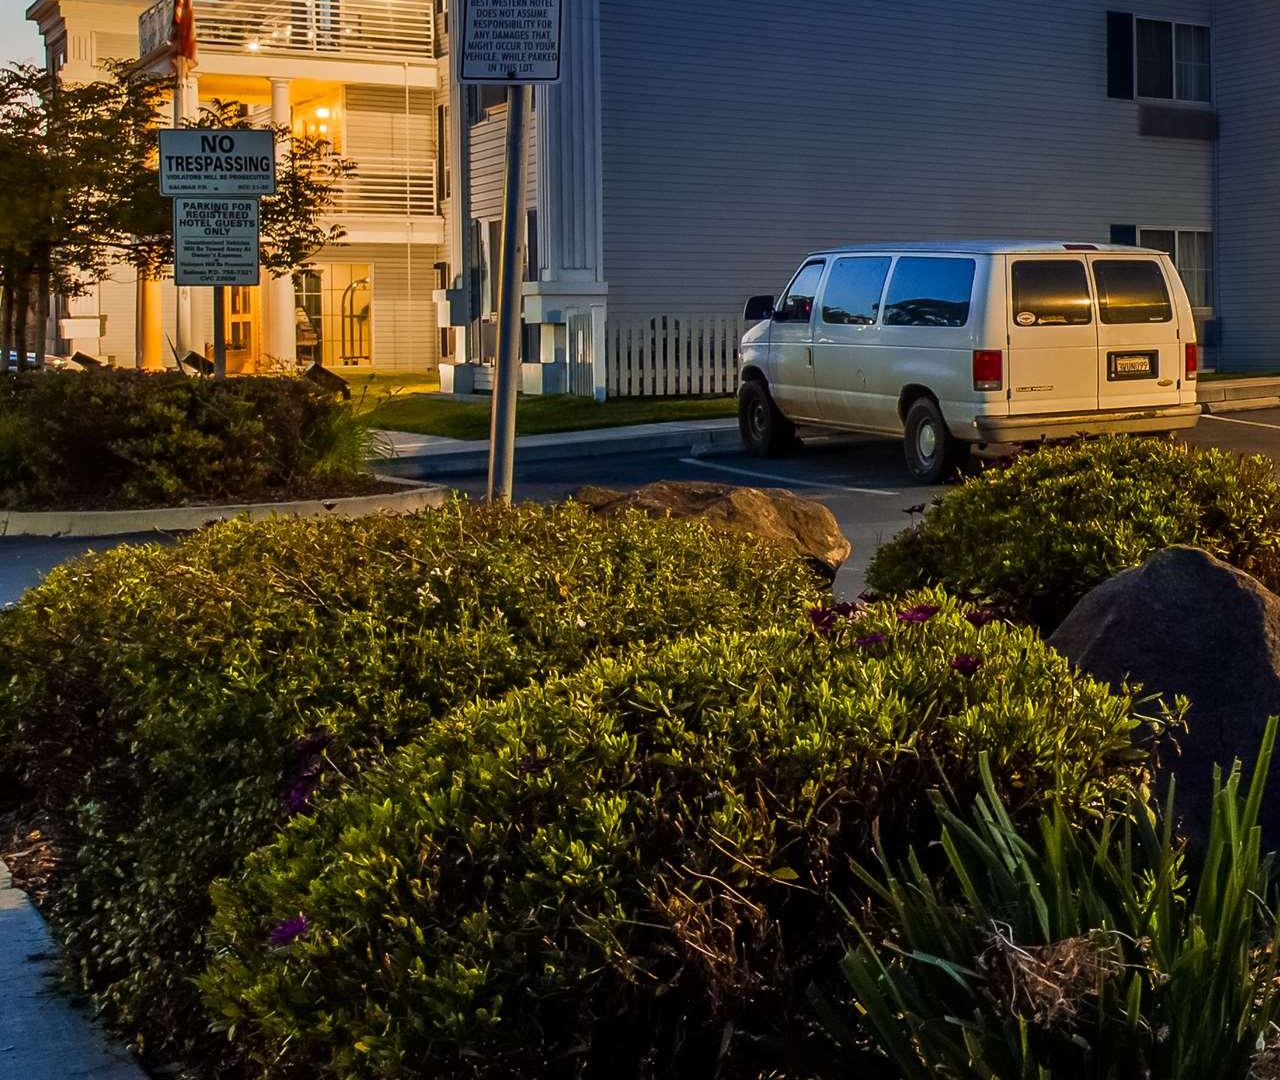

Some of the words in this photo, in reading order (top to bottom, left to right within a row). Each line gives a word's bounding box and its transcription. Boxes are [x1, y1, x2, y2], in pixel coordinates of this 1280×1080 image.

[476, 9, 497, 18] DOES
[500, 9, 515, 18] NOT
[517, 9, 547, 18] ASSUME
[473, 20, 535, 29] RESPONSIBILITY
[537, 20, 552, 29] FOR
[474, 31, 490, 40] ANY
[492, 31, 529, 40] DAMAGES
[531, 31, 551, 40] THAT
[468, 41, 494, 51] MIGHT
[496, 41, 521, 51] OCCUR
[524, 41, 534, 51] TO
[535, 41, 556, 51] YOUR
[502, 52, 527, 61] WHILE
[528, 52, 558, 61] PARKED
[488, 63, 496, 72] IN
[500, 63, 517, 73] THIS
[201, 135, 234, 153] NO
[165, 156, 270, 172] TRESPASSING
[183, 202, 228, 211] PARKING
[232, 202, 252, 211] FOR
[186, 211, 248, 219] REGISTERED
[179, 219, 212, 227] HOTEL
[215, 219, 255, 227] GUESTS
[204, 227, 231, 235] ONLY
